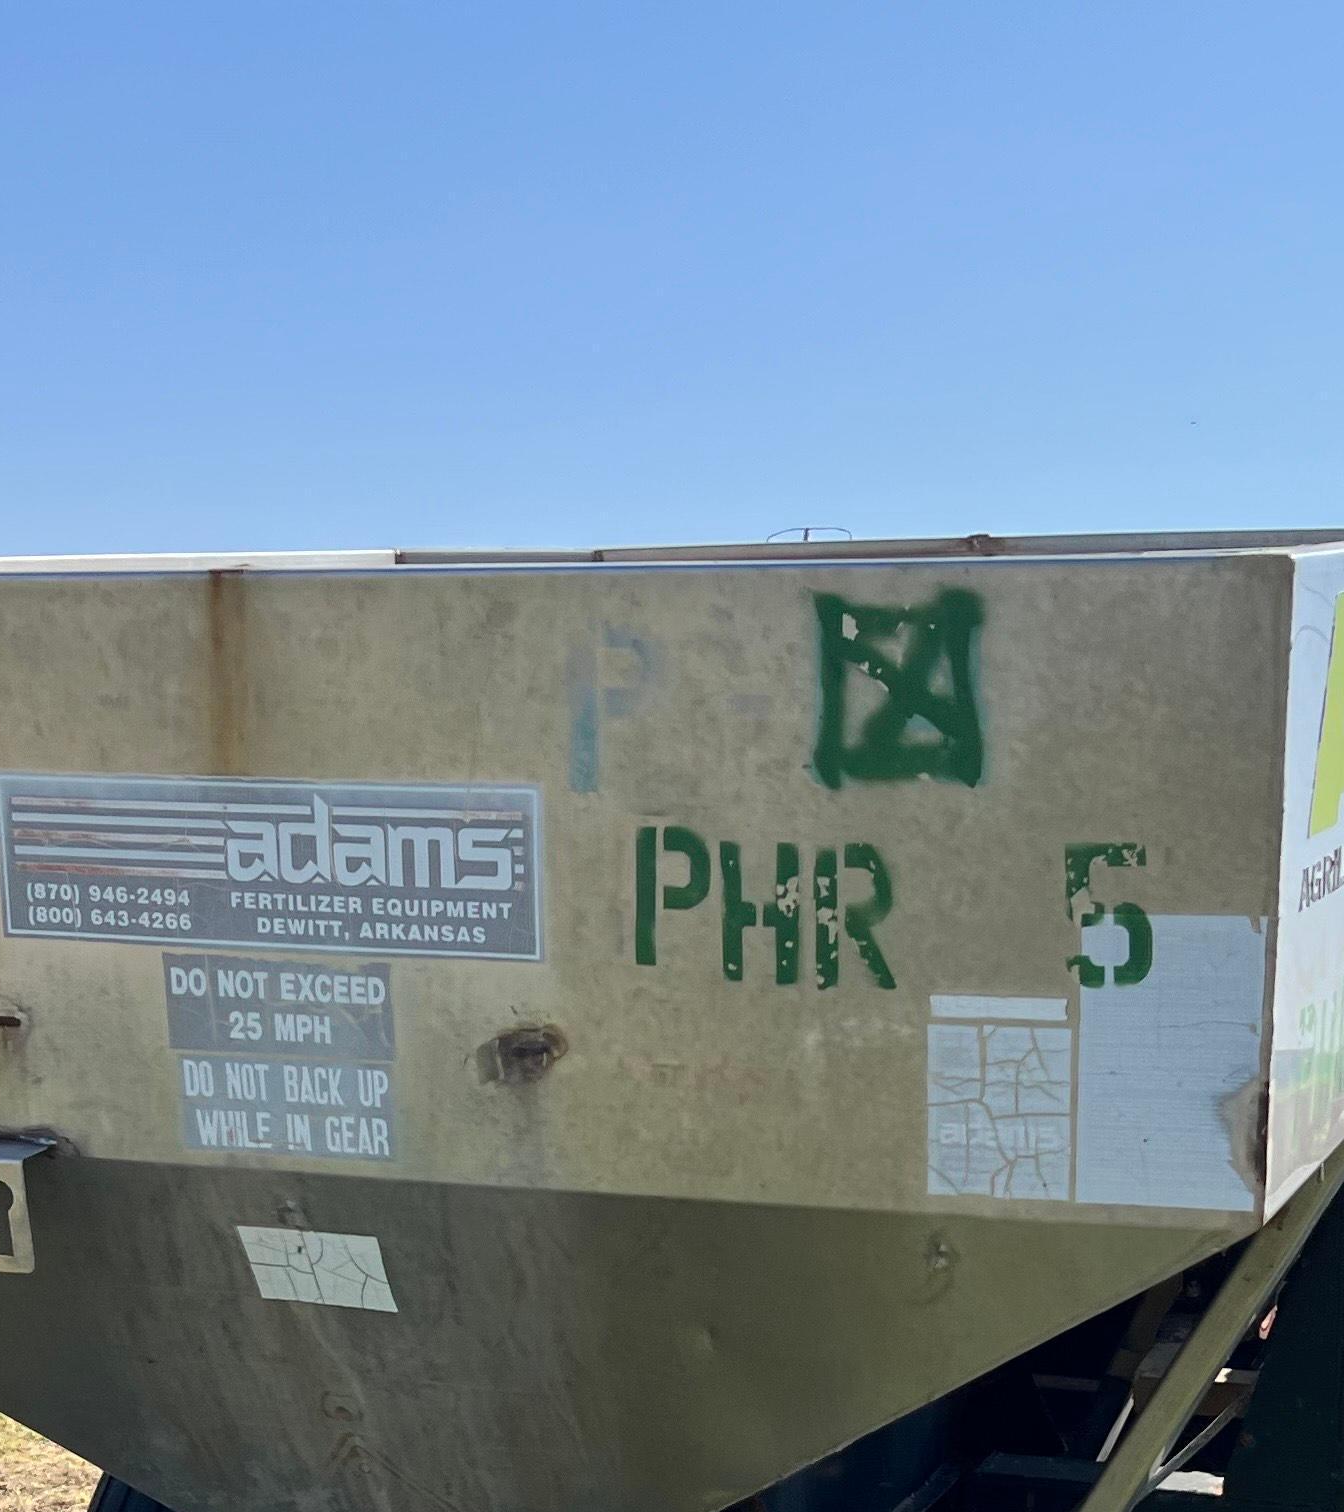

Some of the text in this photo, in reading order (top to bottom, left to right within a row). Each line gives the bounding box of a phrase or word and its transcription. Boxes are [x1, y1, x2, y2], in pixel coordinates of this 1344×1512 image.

[225, 793, 513, 891] adams
[26, 882, 190, 906] (870) 946-2494
[230, 891, 513, 920] FERTILIZER EQUIPMENT
[634, 825, 897, 990] PHR
[28, 905, 192, 931] (800) 643-4266
[256, 916, 487, 944] DEWITT, ARKANSAS
[1064, 842, 1153, 988] 5
[170, 966, 386, 1005] DO NOT EXCEED
[229, 1010, 332, 1044] 25 MPH
[182, 1059, 389, 1108] DO NOT BACK UP
[195, 1109, 390, 1156] WHILE IN GEAR
